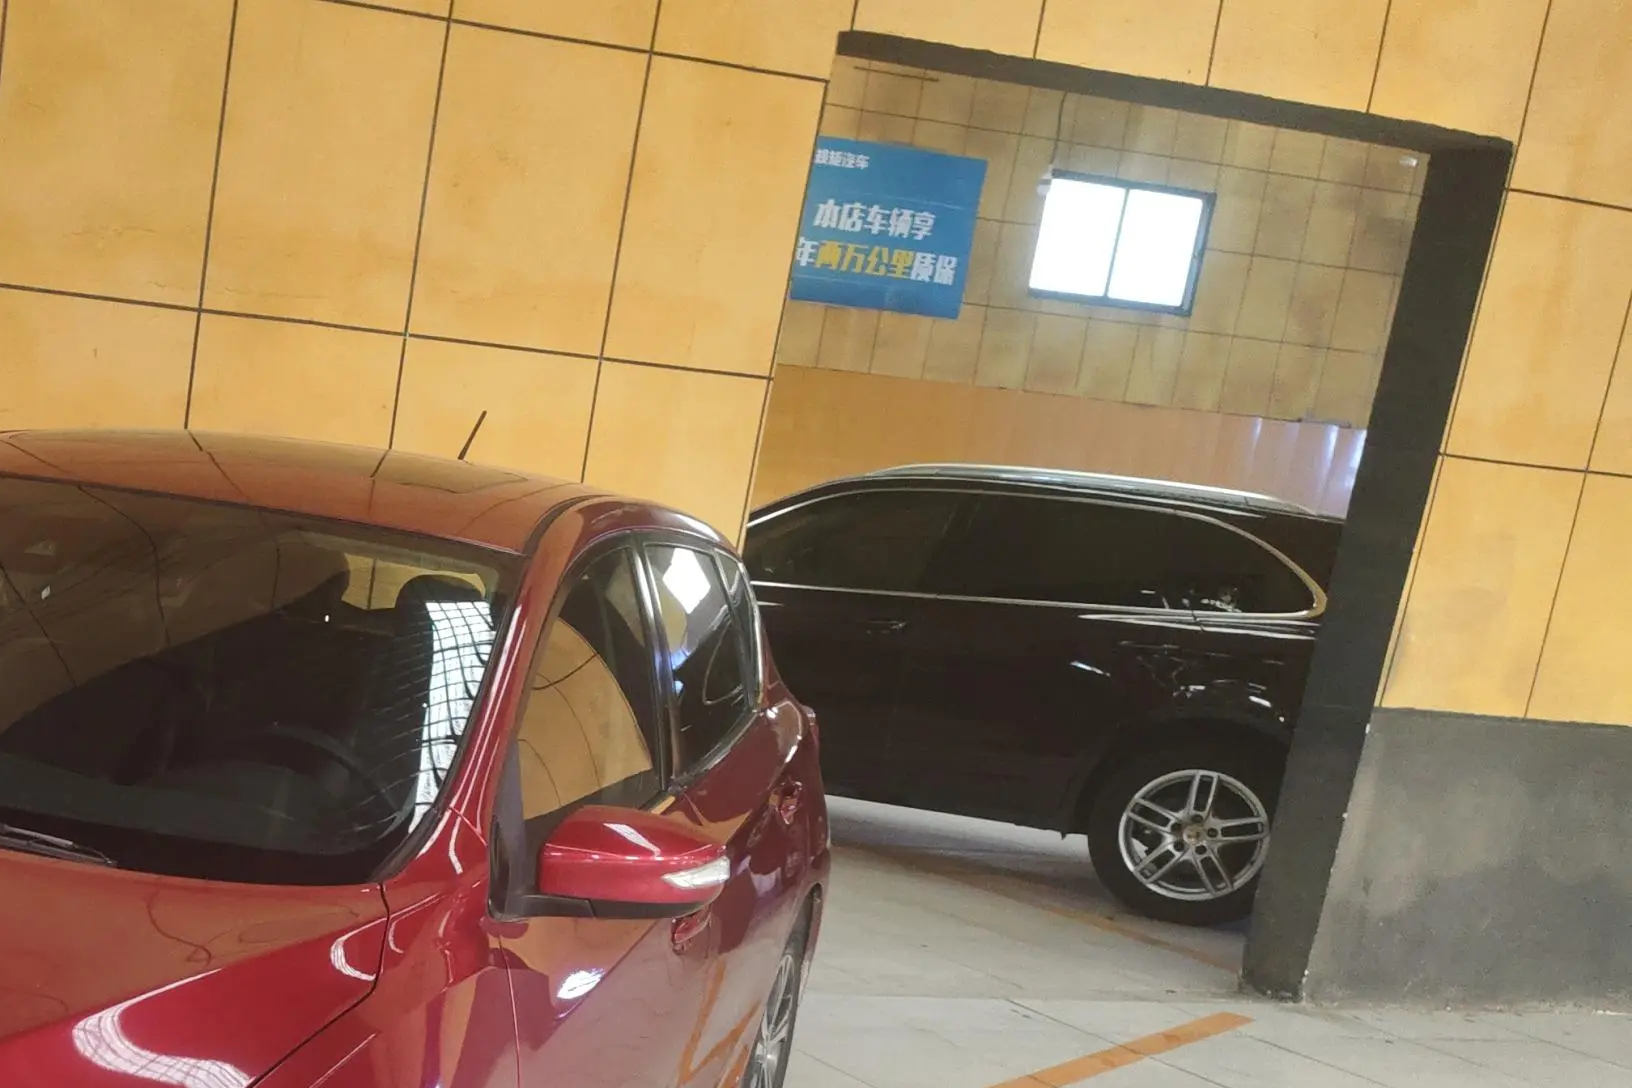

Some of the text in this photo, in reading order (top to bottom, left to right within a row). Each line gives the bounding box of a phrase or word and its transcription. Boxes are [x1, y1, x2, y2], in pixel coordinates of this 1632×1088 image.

[813, 198, 936, 240] 本店车辆享
